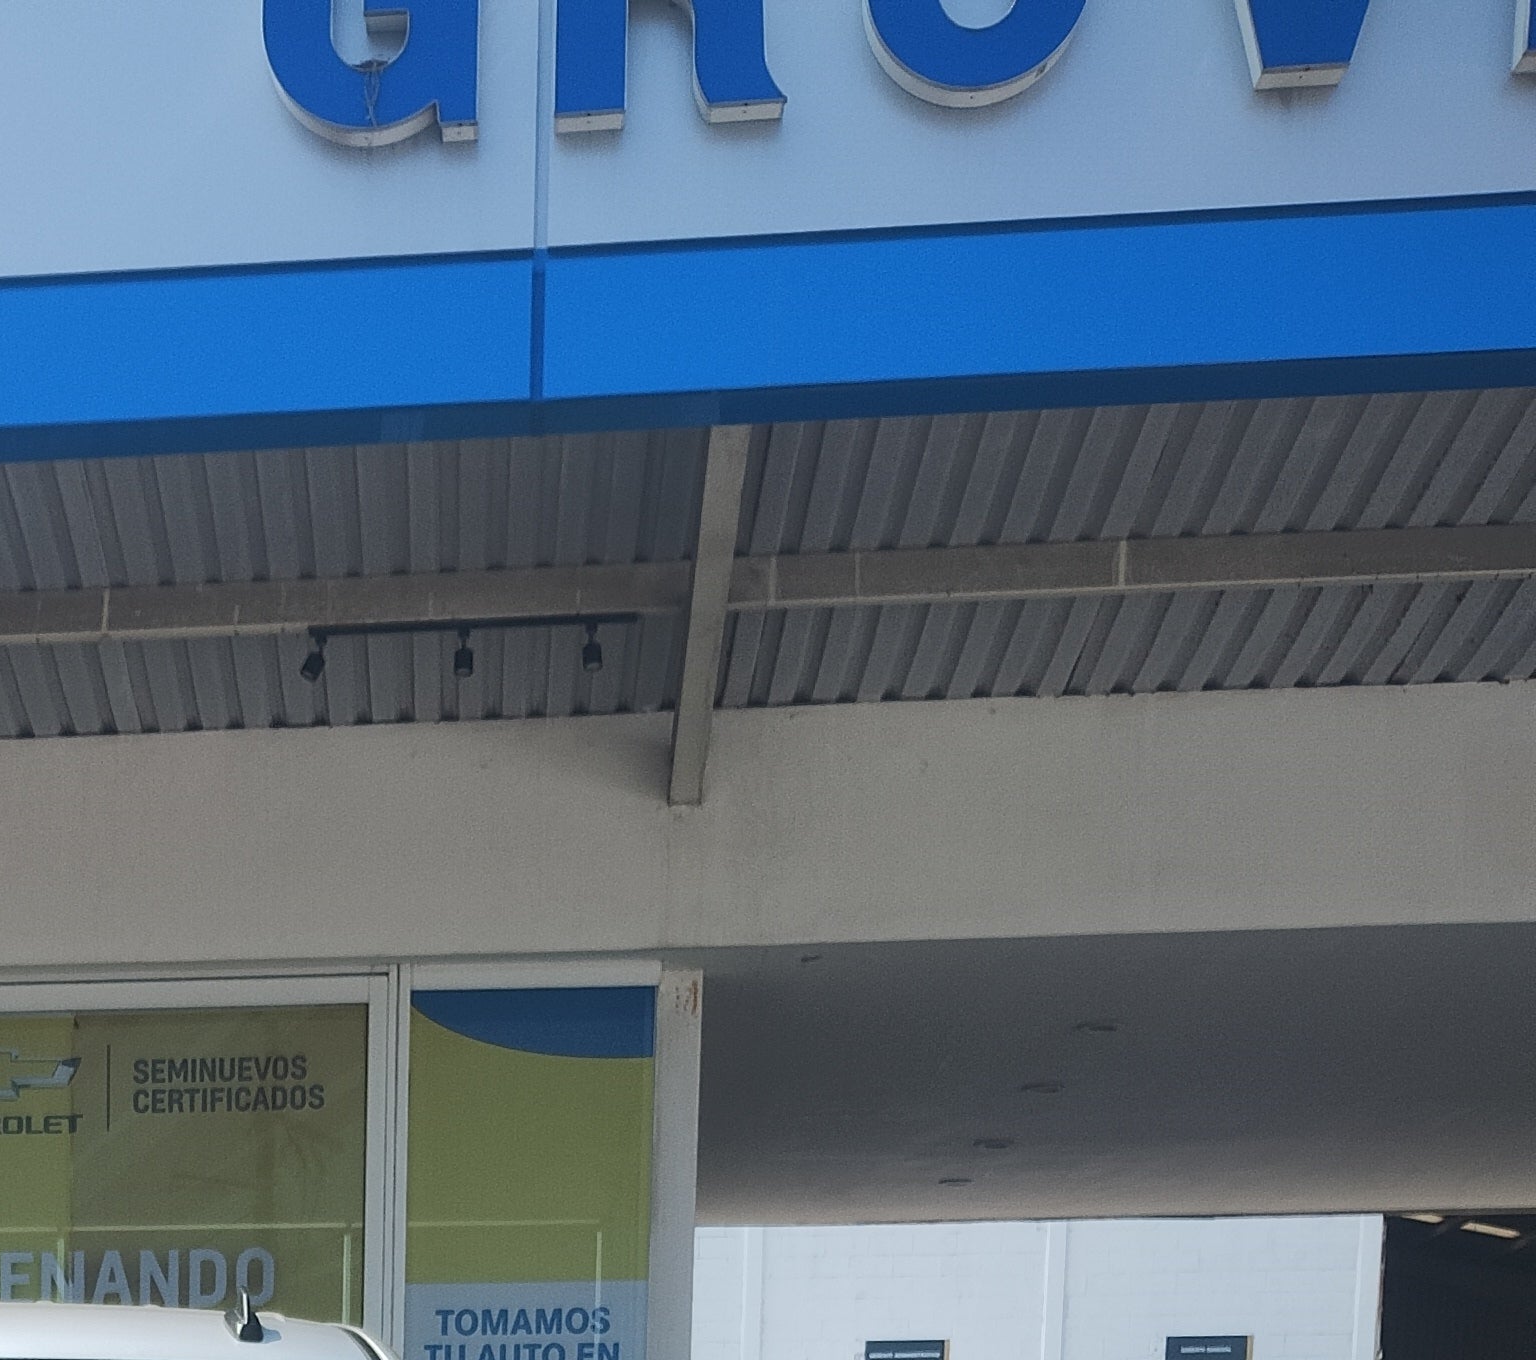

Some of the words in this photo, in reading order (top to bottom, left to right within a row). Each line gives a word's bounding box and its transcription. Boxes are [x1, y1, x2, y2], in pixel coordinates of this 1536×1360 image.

[133, 1055, 308, 1084] SEMINUEVOS
[133, 1084, 325, 1115] CERTIFICADOS
[434, 1307, 611, 1337] TOMAMOS
